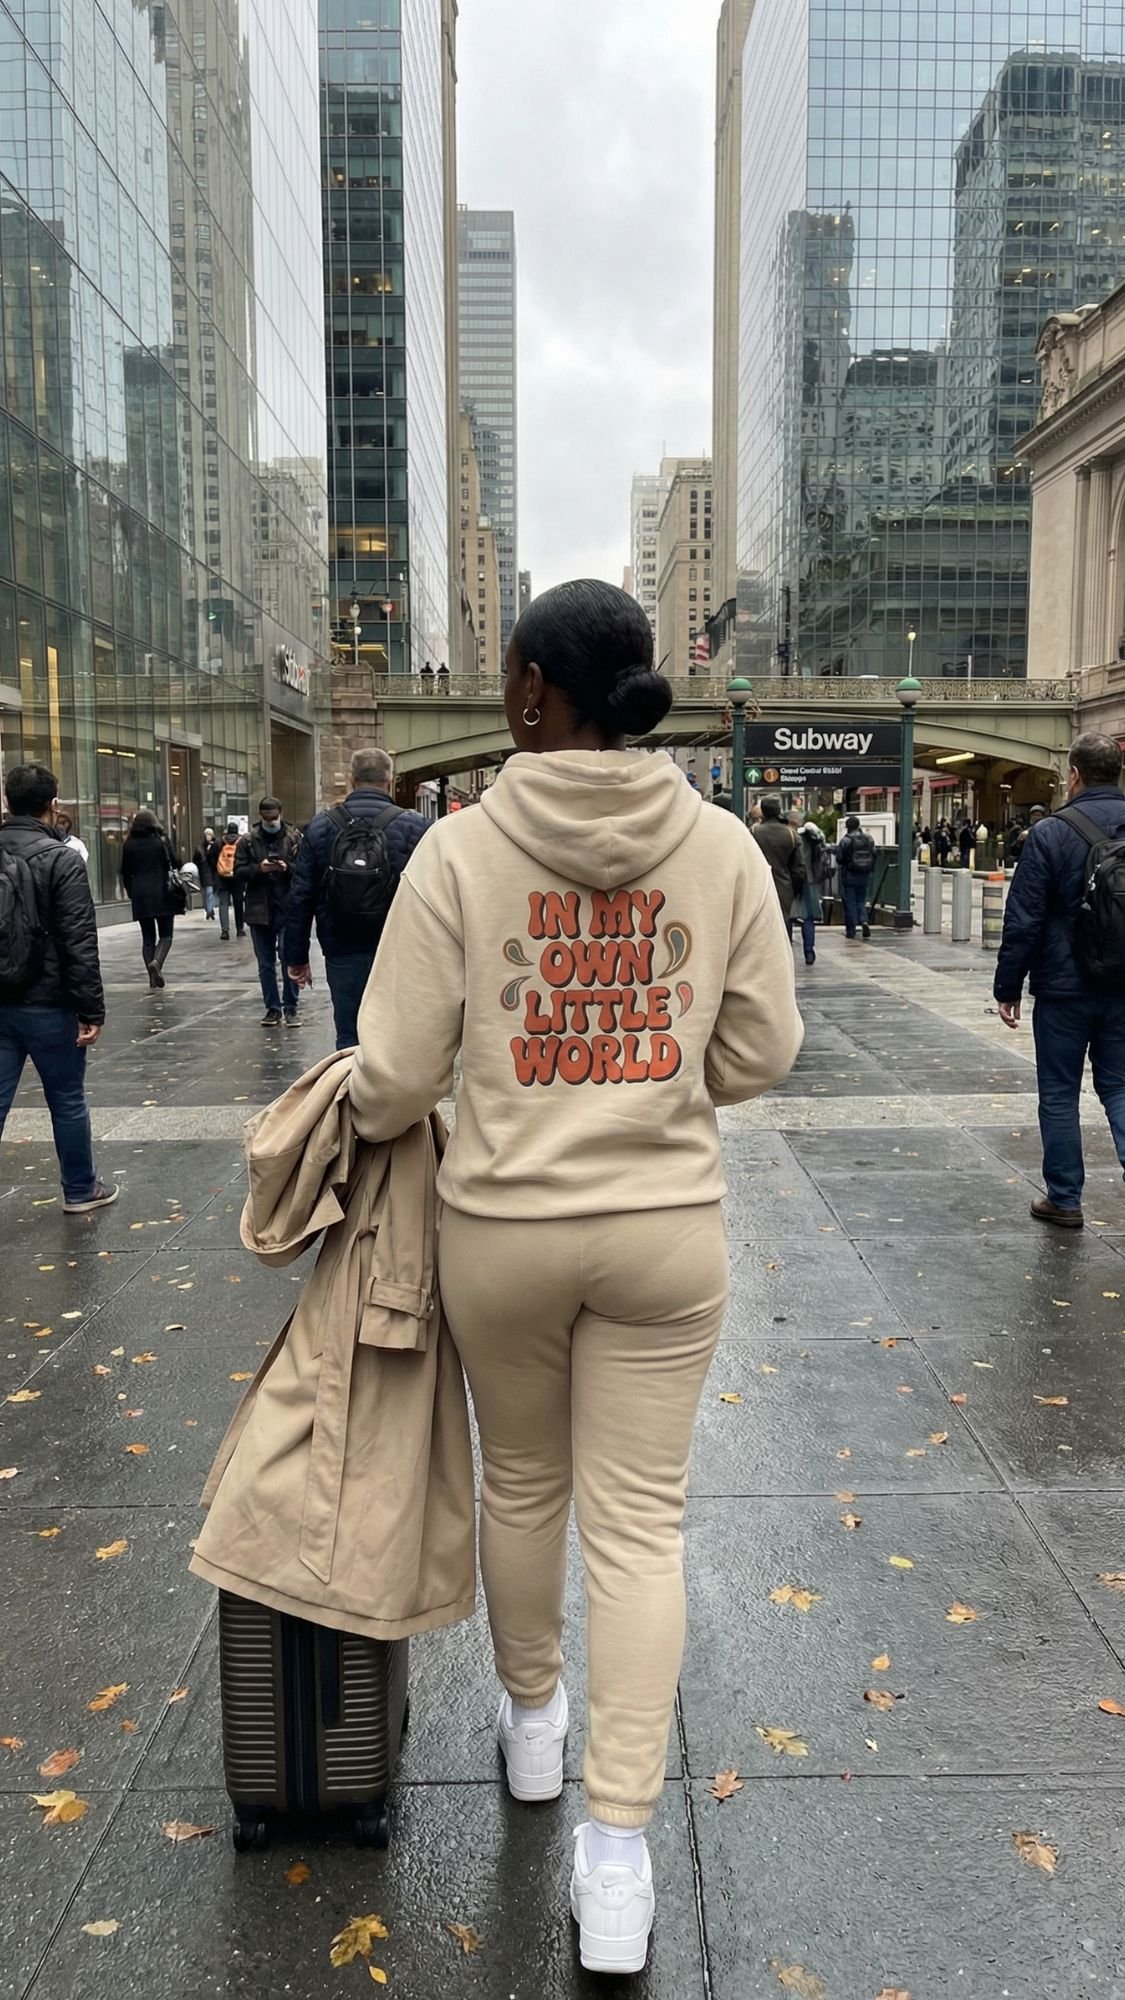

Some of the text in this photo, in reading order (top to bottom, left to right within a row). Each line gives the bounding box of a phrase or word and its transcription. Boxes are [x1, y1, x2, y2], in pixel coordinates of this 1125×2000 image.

[774, 727, 873, 755] Subway
[528, 889, 665, 940] IN MY
[540, 939, 655, 988] OWN
[524, 986, 672, 1035] LITTLE
[510, 1033, 682, 1086] WORLD
